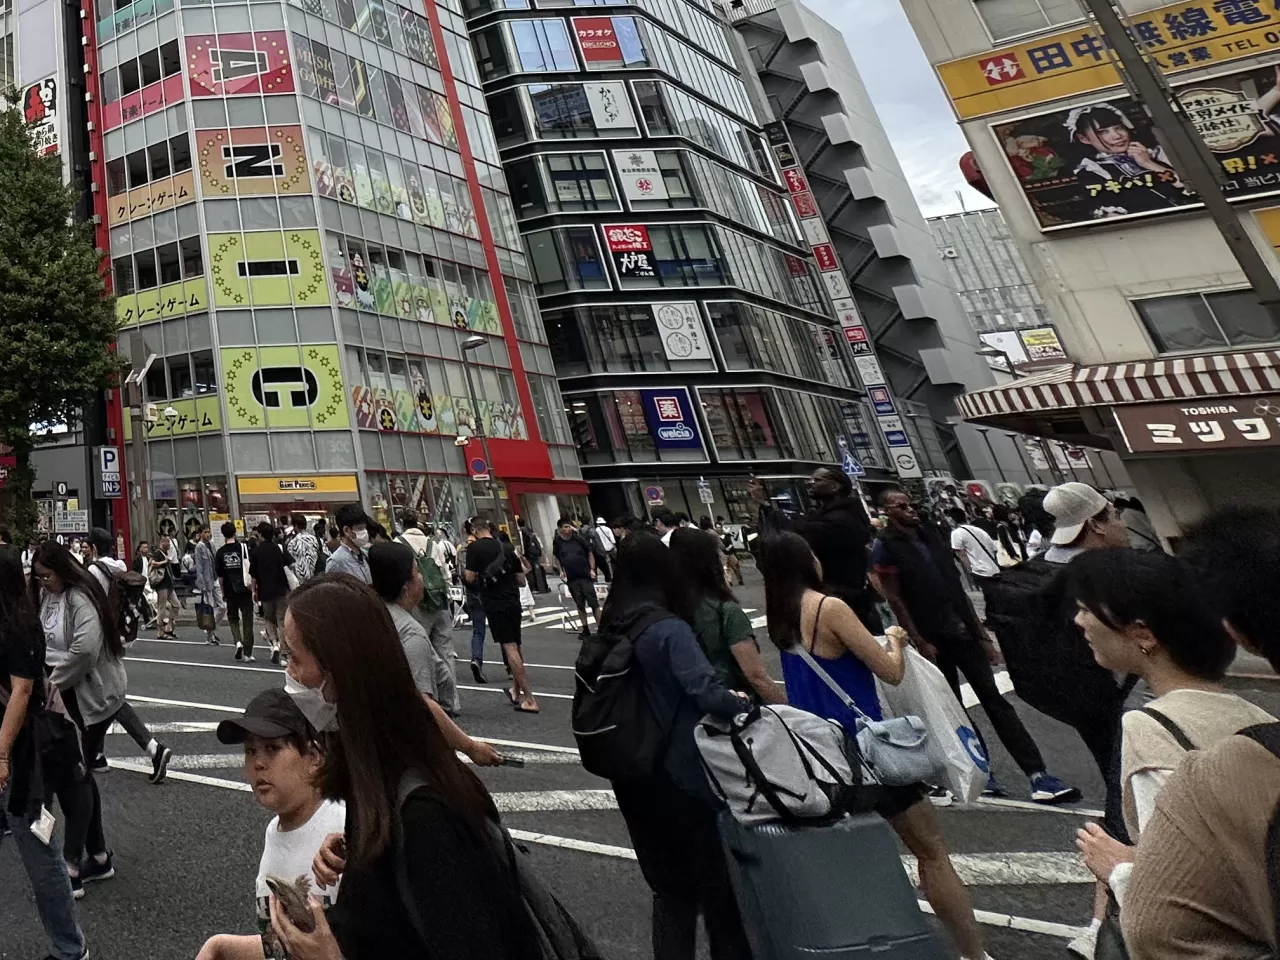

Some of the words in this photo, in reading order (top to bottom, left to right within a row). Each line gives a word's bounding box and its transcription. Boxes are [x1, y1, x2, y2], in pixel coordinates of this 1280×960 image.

[578, 29, 613, 38] カラオケ
[1221, 38, 1260, 53] TEL
[296, 48, 334, 71] MUSIC
[117, 185, 189, 218] クレーンゲーム
[620, 251, 653, 273] 大戸屋
[124, 293, 200, 322] クレーンゲーム
[1180, 405, 1239, 416] TOSHIBA
[142, 411, 214, 435] レーンゲーム
[660, 428, 691, 438] welcia
[103, 450, 116, 470] P
[102, 482, 113, 492] IN
[279, 480, 294, 489] GAME
[294, 480, 311, 489] PANIC
